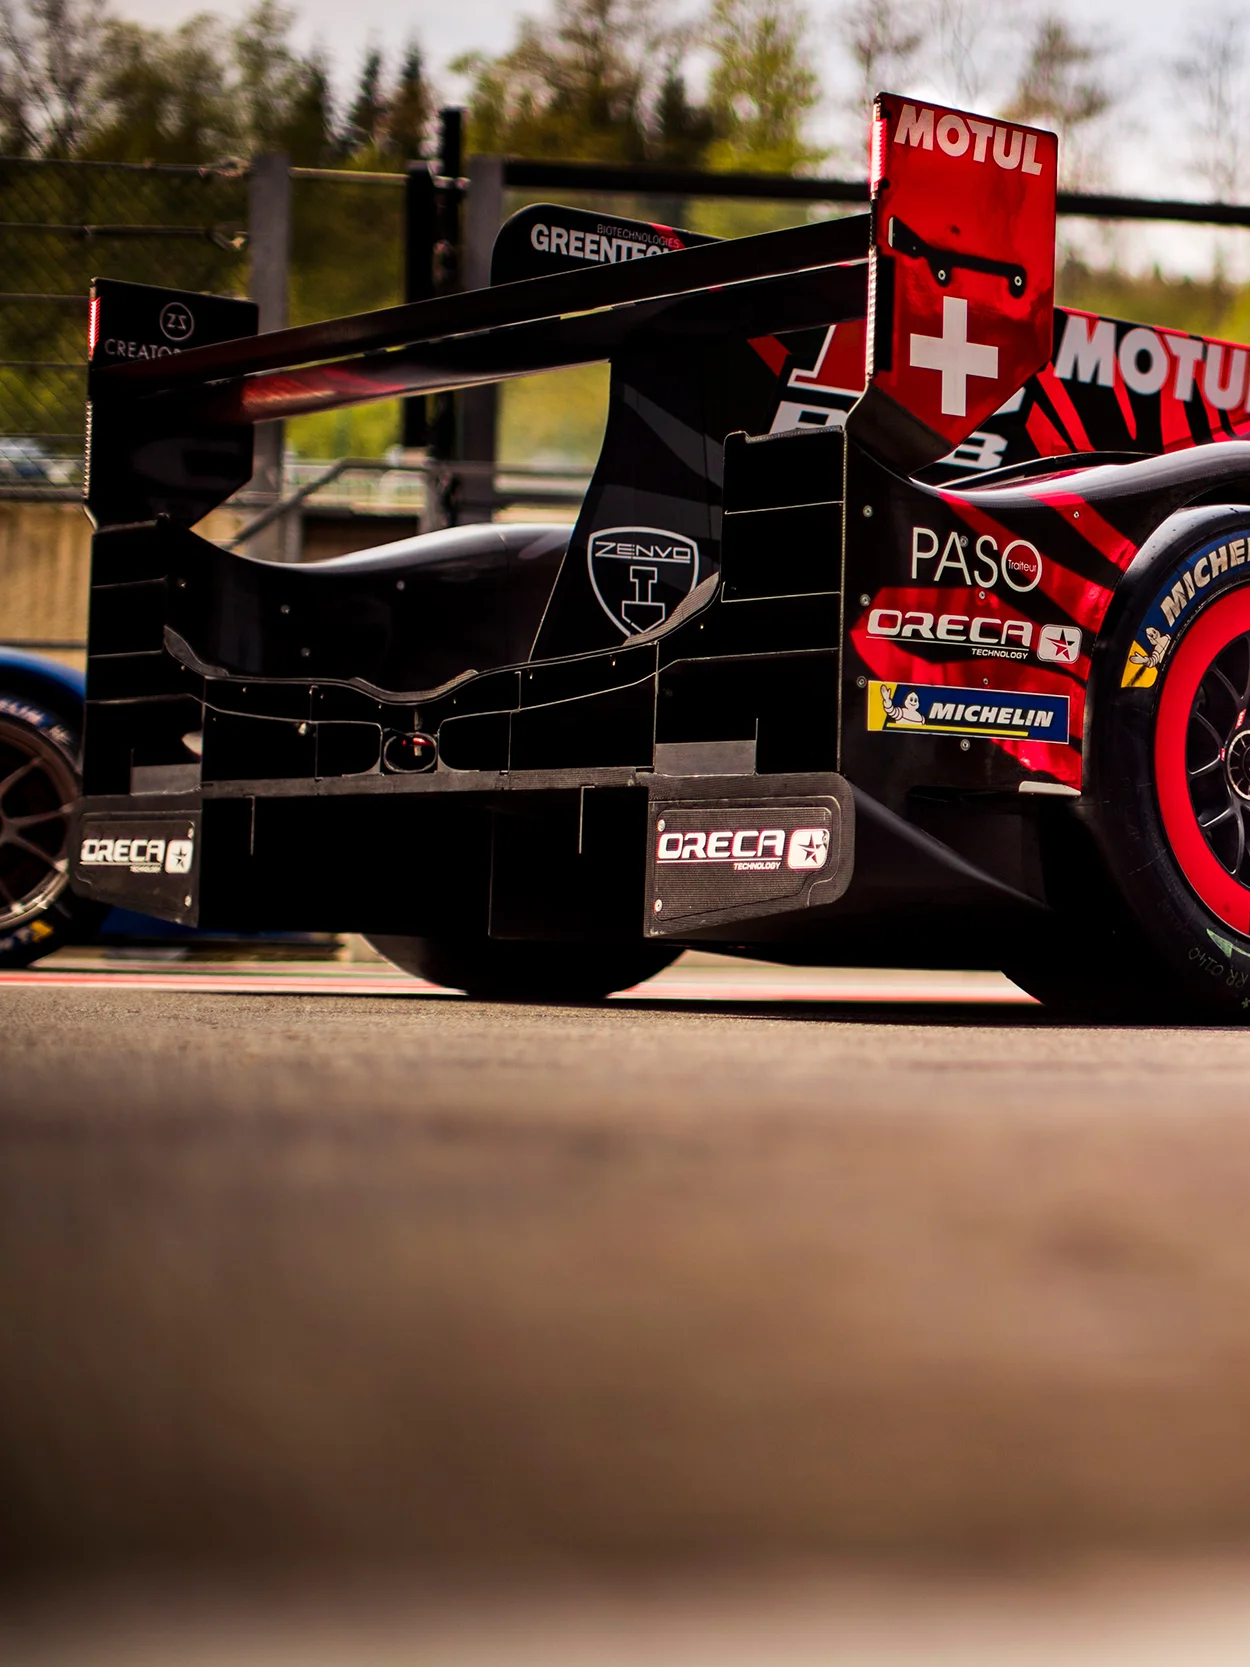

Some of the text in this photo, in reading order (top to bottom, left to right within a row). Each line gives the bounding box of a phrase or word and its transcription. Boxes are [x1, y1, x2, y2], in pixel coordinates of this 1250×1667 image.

[894, 103, 1043, 176] MOTUL
[597, 223, 680, 249] BIOTECHNOLOGIES
[594, 541, 691, 562] ZENVO
[911, 526, 1043, 593] PASO
[1007, 558, 1037, 575] Traiteur
[866, 608, 1034, 646] ORECA
[971, 647, 1030, 660] TECHNOLOGY
[927, 701, 1055, 729] MICHELIN
[80, 839, 166, 863] ORECA
[656, 829, 786, 859] ORECA
[733, 862, 781, 871] TECHNOLOGY
